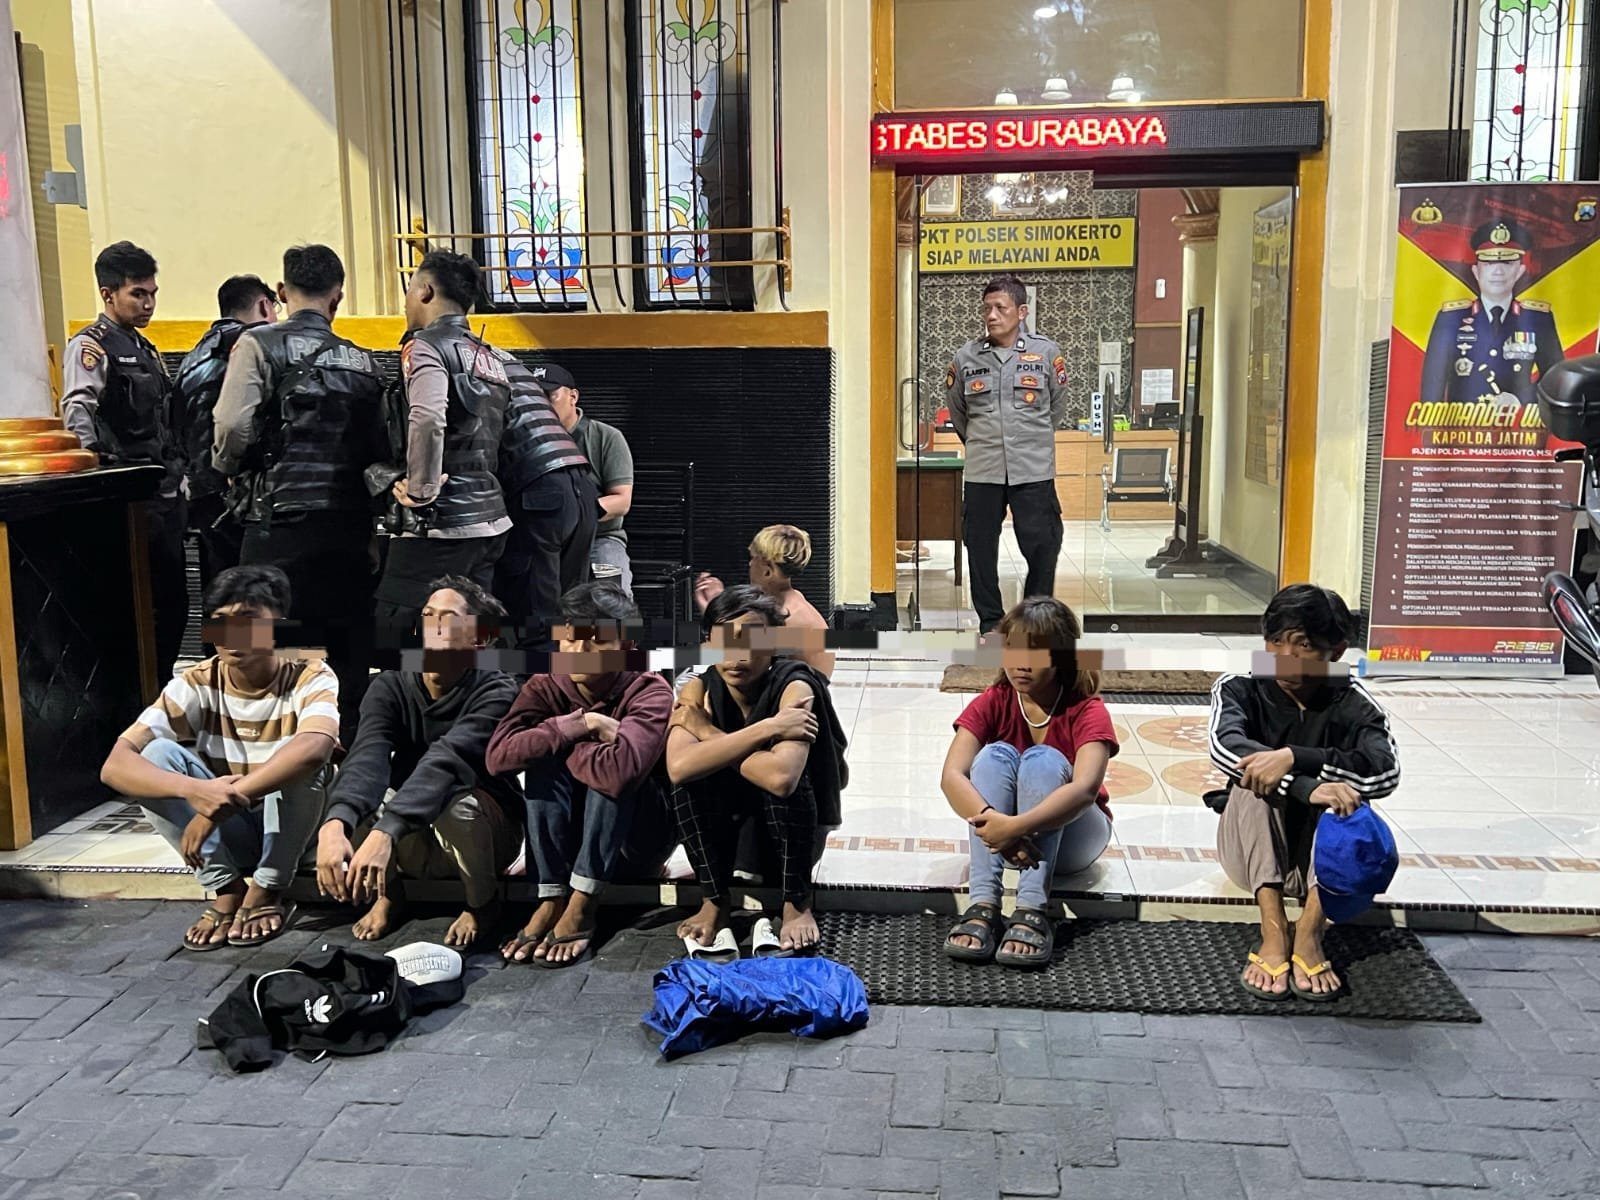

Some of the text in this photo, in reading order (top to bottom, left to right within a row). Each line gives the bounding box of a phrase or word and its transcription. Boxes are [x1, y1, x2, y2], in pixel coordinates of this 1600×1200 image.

[996, 117, 1167, 148] SURABAYA
[955, 226, 1019, 244] POLSEK
[1024, 224, 1122, 240] SIMOKERTO
[926, 246, 1100, 266] SIAP MELAYANI ANDA
[1094, 394, 1102, 428] PUSH
[1406, 402, 1521, 427] COMMANDER
[1432, 431, 1537, 446] KAPOLDA JATIM
[1494, 641, 1554, 651] PRESISI
